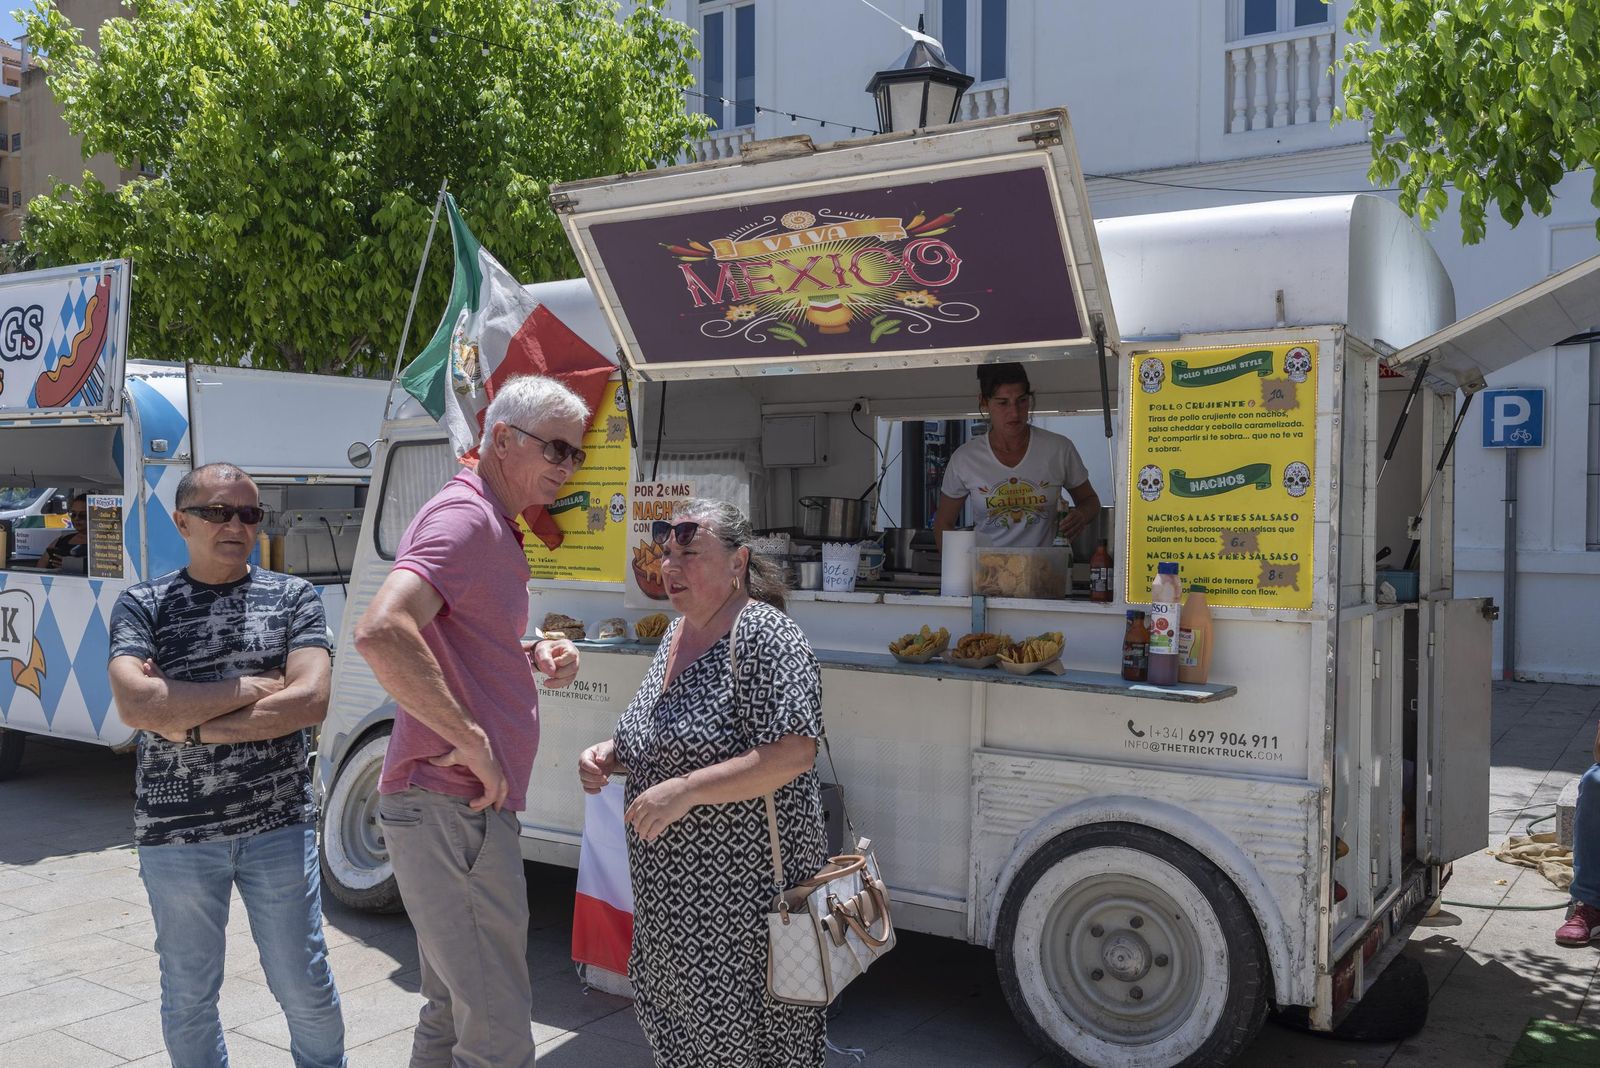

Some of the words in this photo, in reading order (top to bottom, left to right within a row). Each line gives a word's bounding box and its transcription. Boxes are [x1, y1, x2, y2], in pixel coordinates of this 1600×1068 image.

[762, 225, 848, 251] VIVA
[678, 238, 962, 308] MEXICO
[1178, 371, 1201, 381] POLLO
[1203, 363, 1237, 376] MEXICAN
[1239, 358, 1263, 369] STYLE
[1149, 403, 1183, 411] POLLO
[1185, 400, 1246, 410] CRUJIENTE
[1148, 415, 1166, 423] Tiras
[1168, 414, 1178, 422] de
[1180, 413, 1200, 423] pollo
[1202, 412, 1236, 422] crujiente
[1256, 410, 1289, 419] nachos,
[1494, 395, 1531, 442] P
[1148, 425, 1168, 433] salsa
[1170, 424, 1204, 432] cheddar
[1212, 422, 1243, 430] cebolla
[1244, 420, 1304, 429] caramelizada.
[1162, 434, 1200, 444] compartir
[1202, 433, 1209, 441] si
[1210, 433, 1218, 441] te
[1220, 432, 1250, 441] sobra...
[1252, 433, 1268, 442] que
[1282, 431, 1291, 439] te
[1189, 473, 1246, 492] NACHOS
[634, 485, 653, 497] POR
[632, 500, 684, 520] NACH
[1147, 514, 1185, 522] NACHOS
[1187, 514, 1194, 522] A
[1196, 514, 1216, 522] LAS
[1218, 513, 1247, 522] TRES
[1249, 513, 1289, 522] SALSAS
[633, 522, 650, 533] CON
[1147, 525, 1187, 534] Crujientes,
[1278, 526, 1295, 534] que
[1147, 535, 1171, 543] bailan
[1194, 535, 1217, 543] boca.
[1147, 552, 1185, 560] NACHOS
[1187, 552, 1194, 560] A
[1196, 552, 1216, 560] LAS
[1249, 552, 1289, 561] SALSAS
[1147, 564, 1154, 572] Y
[1193, 576, 1210, 584] chili
[1224, 577, 1254, 585] ternera
[1258, 587, 1278, 596] flow.
[1, 606, 21, 643] K
[573, 680, 590, 691] 904
[592, 682, 608, 694] 911
[538, 688, 611, 702] THETRICKTRUCK.COM
[1188, 729, 1215, 743] 697
[1219, 731, 1247, 746] 904
[1251, 734, 1278, 749] 911
[1124, 739, 1283, 761] INFO@THETRICKTRUCK.COM
